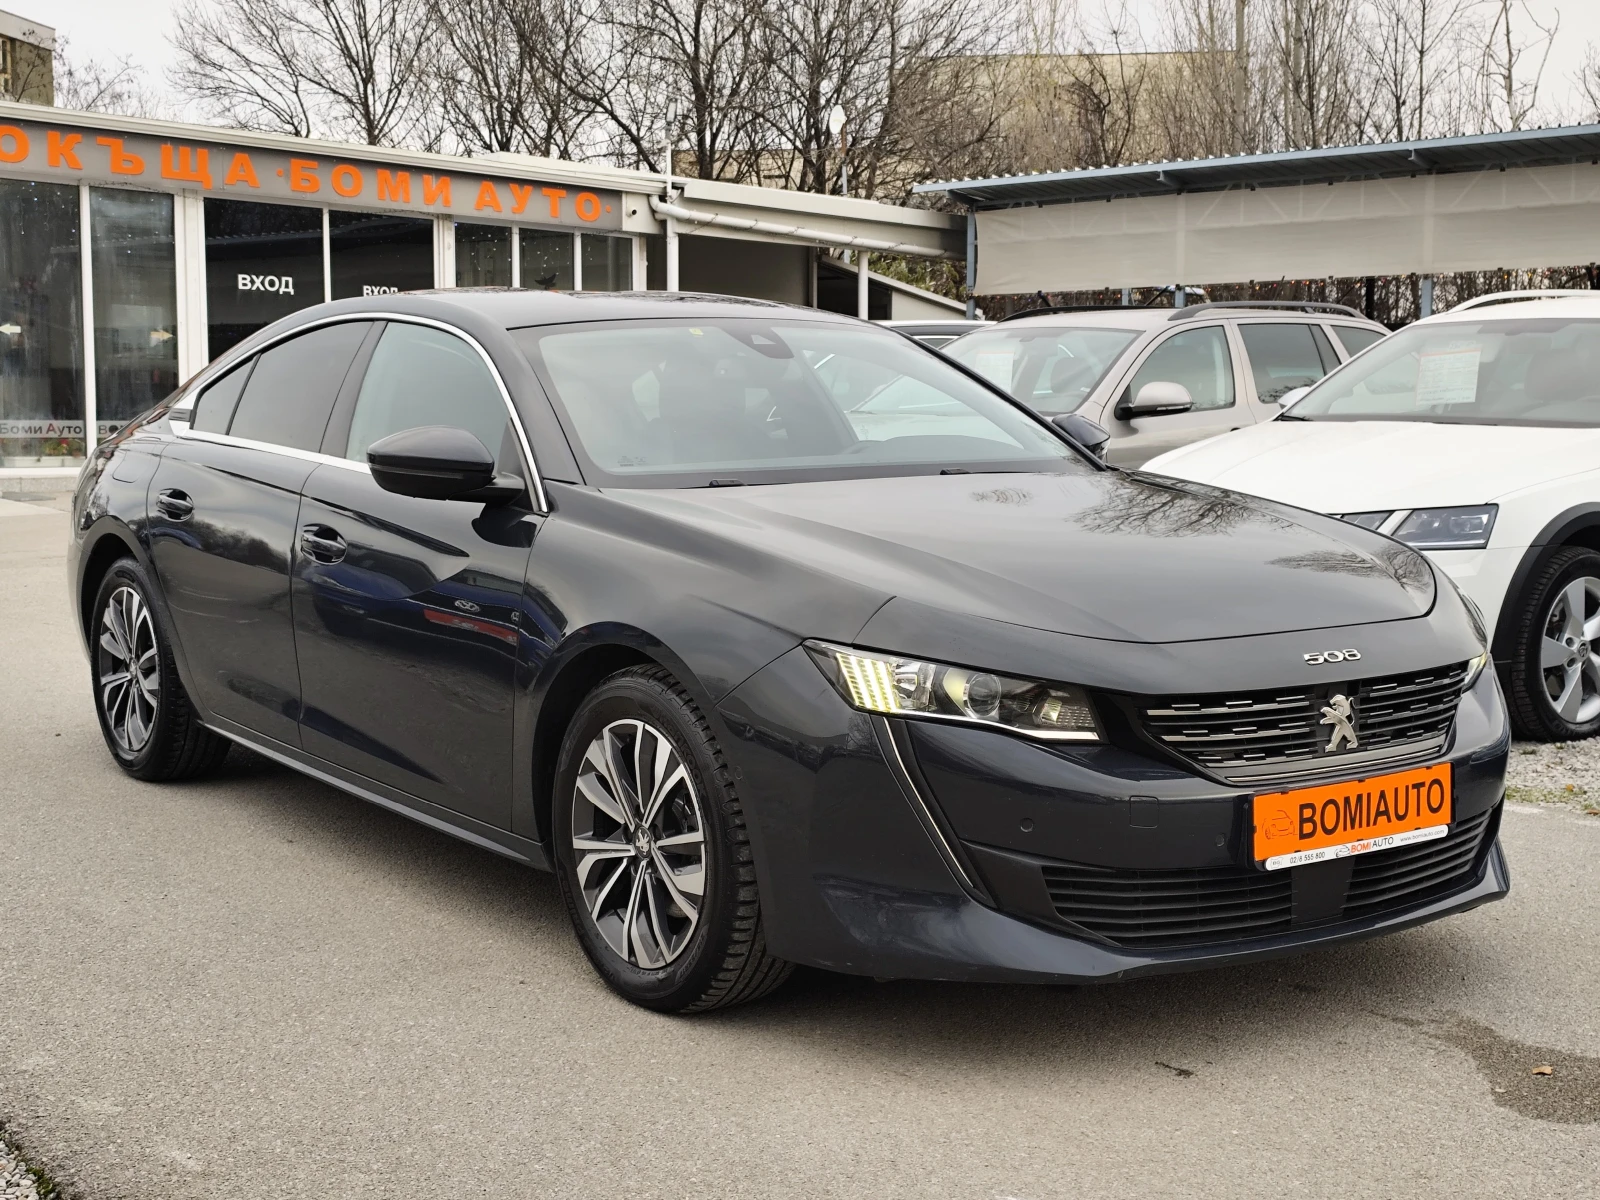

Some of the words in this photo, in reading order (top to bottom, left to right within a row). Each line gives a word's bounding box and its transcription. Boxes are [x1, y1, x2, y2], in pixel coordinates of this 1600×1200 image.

[289, 158, 453, 207] БОМИ
[474, 181, 601, 222] АУТО
[237, 274, 295, 295] ВХОД
[46, 423, 82, 437] Ауто
[1304, 648, 1361, 665] 508
[1299, 778, 1445, 841] BOMIAUTO
[1350, 841, 1371, 853] BOMI
[1372, 836, 1394, 848] AUTO
